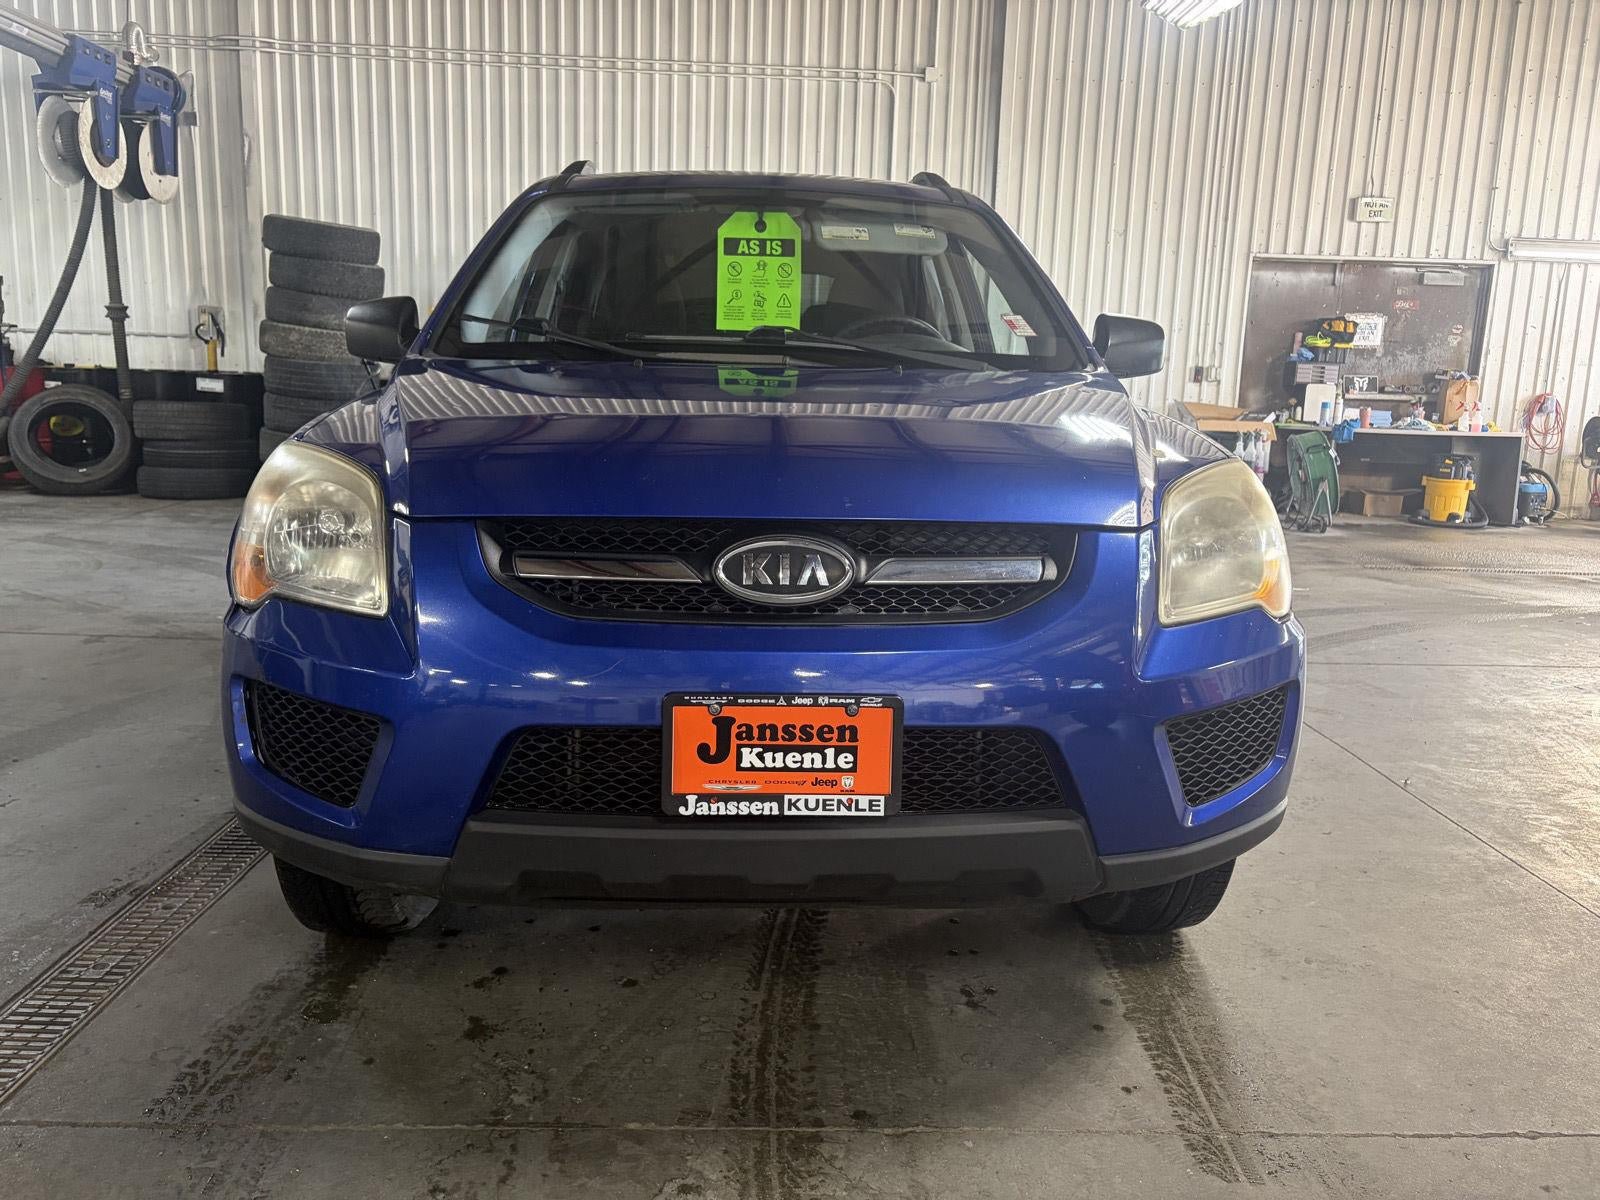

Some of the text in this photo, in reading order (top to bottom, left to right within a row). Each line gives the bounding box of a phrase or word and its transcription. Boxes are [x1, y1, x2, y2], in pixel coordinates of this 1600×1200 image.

[1368, 209, 1383, 217] EXIT
[737, 239, 782, 255] AS IS
[742, 553, 830, 586] KIA
[791, 696, 814, 706] Jeep
[696, 715, 859, 765] Janssen
[740, 747, 854, 769] Kuenle
[811, 776, 838, 788] Jeep
[678, 794, 882, 816] Janssen KUENLE
